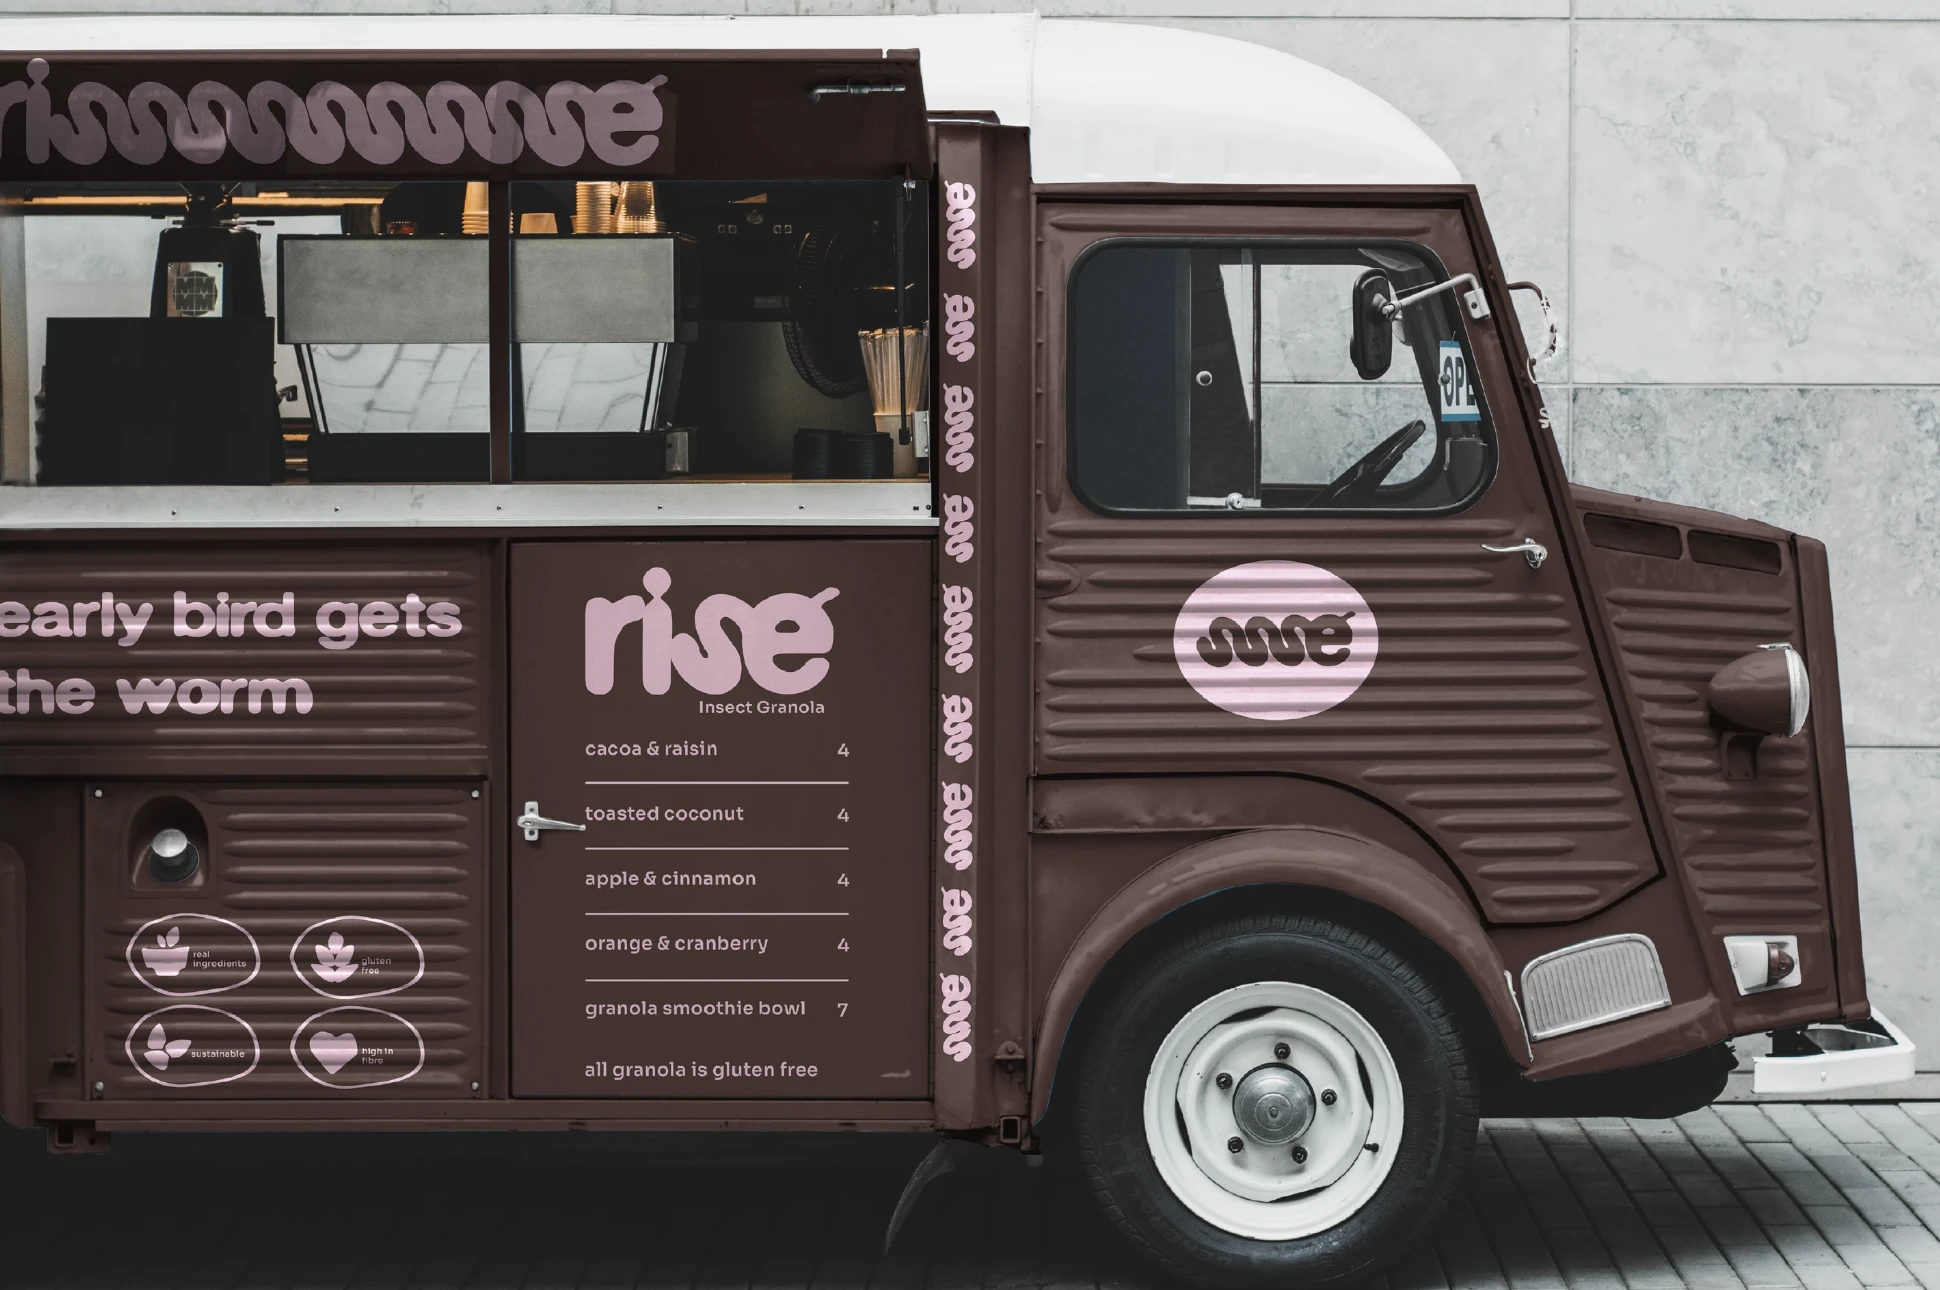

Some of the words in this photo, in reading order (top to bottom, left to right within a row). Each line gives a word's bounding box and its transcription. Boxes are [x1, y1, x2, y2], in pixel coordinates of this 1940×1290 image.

[0, 591, 153, 647] early
[173, 591, 296, 638] bird
[316, 593, 463, 650] gets
[585, 567, 840, 695] rise
[0, 668, 96, 715] the
[116, 678, 314, 715] worm
[699, 700, 753, 714] Insect
[757, 700, 825, 714] Granola
[585, 743, 642, 756] cacoa
[647, 740, 660, 756] &
[665, 740, 718, 756] raisin
[837, 743, 850, 758] 4
[585, 806, 659, 822] toasted
[664, 807, 744, 822] coconut
[837, 808, 850, 823] 4
[585, 871, 640, 889] apple
[644, 870, 657, 886] &
[661, 871, 756, 886] cinnamon
[837, 873, 850, 887] 4
[193, 950, 210, 958] real
[585, 939, 653, 955] orange
[657, 936, 671, 951] &
[674, 936, 769, 955] cranberry
[837, 938, 850, 953] 4
[193, 959, 247, 970] ingredients
[361, 957, 392, 967] gluten
[361, 967, 380, 975] free
[585, 1000, 658, 1020] granola
[662, 1000, 754, 1016] smoothie
[759, 1000, 806, 1016] bowl
[837, 1003, 849, 1018] 7
[191, 1049, 246, 1059] sustainable
[361, 1047, 382, 1057] high
[384, 1047, 394, 1055] in
[361, 1057, 384, 1065] fibre
[585, 1062, 607, 1077] all
[612, 1062, 686, 1081] granola
[691, 1062, 708, 1077] is
[712, 1062, 775, 1081] gluten
[780, 1062, 818, 1078] free
